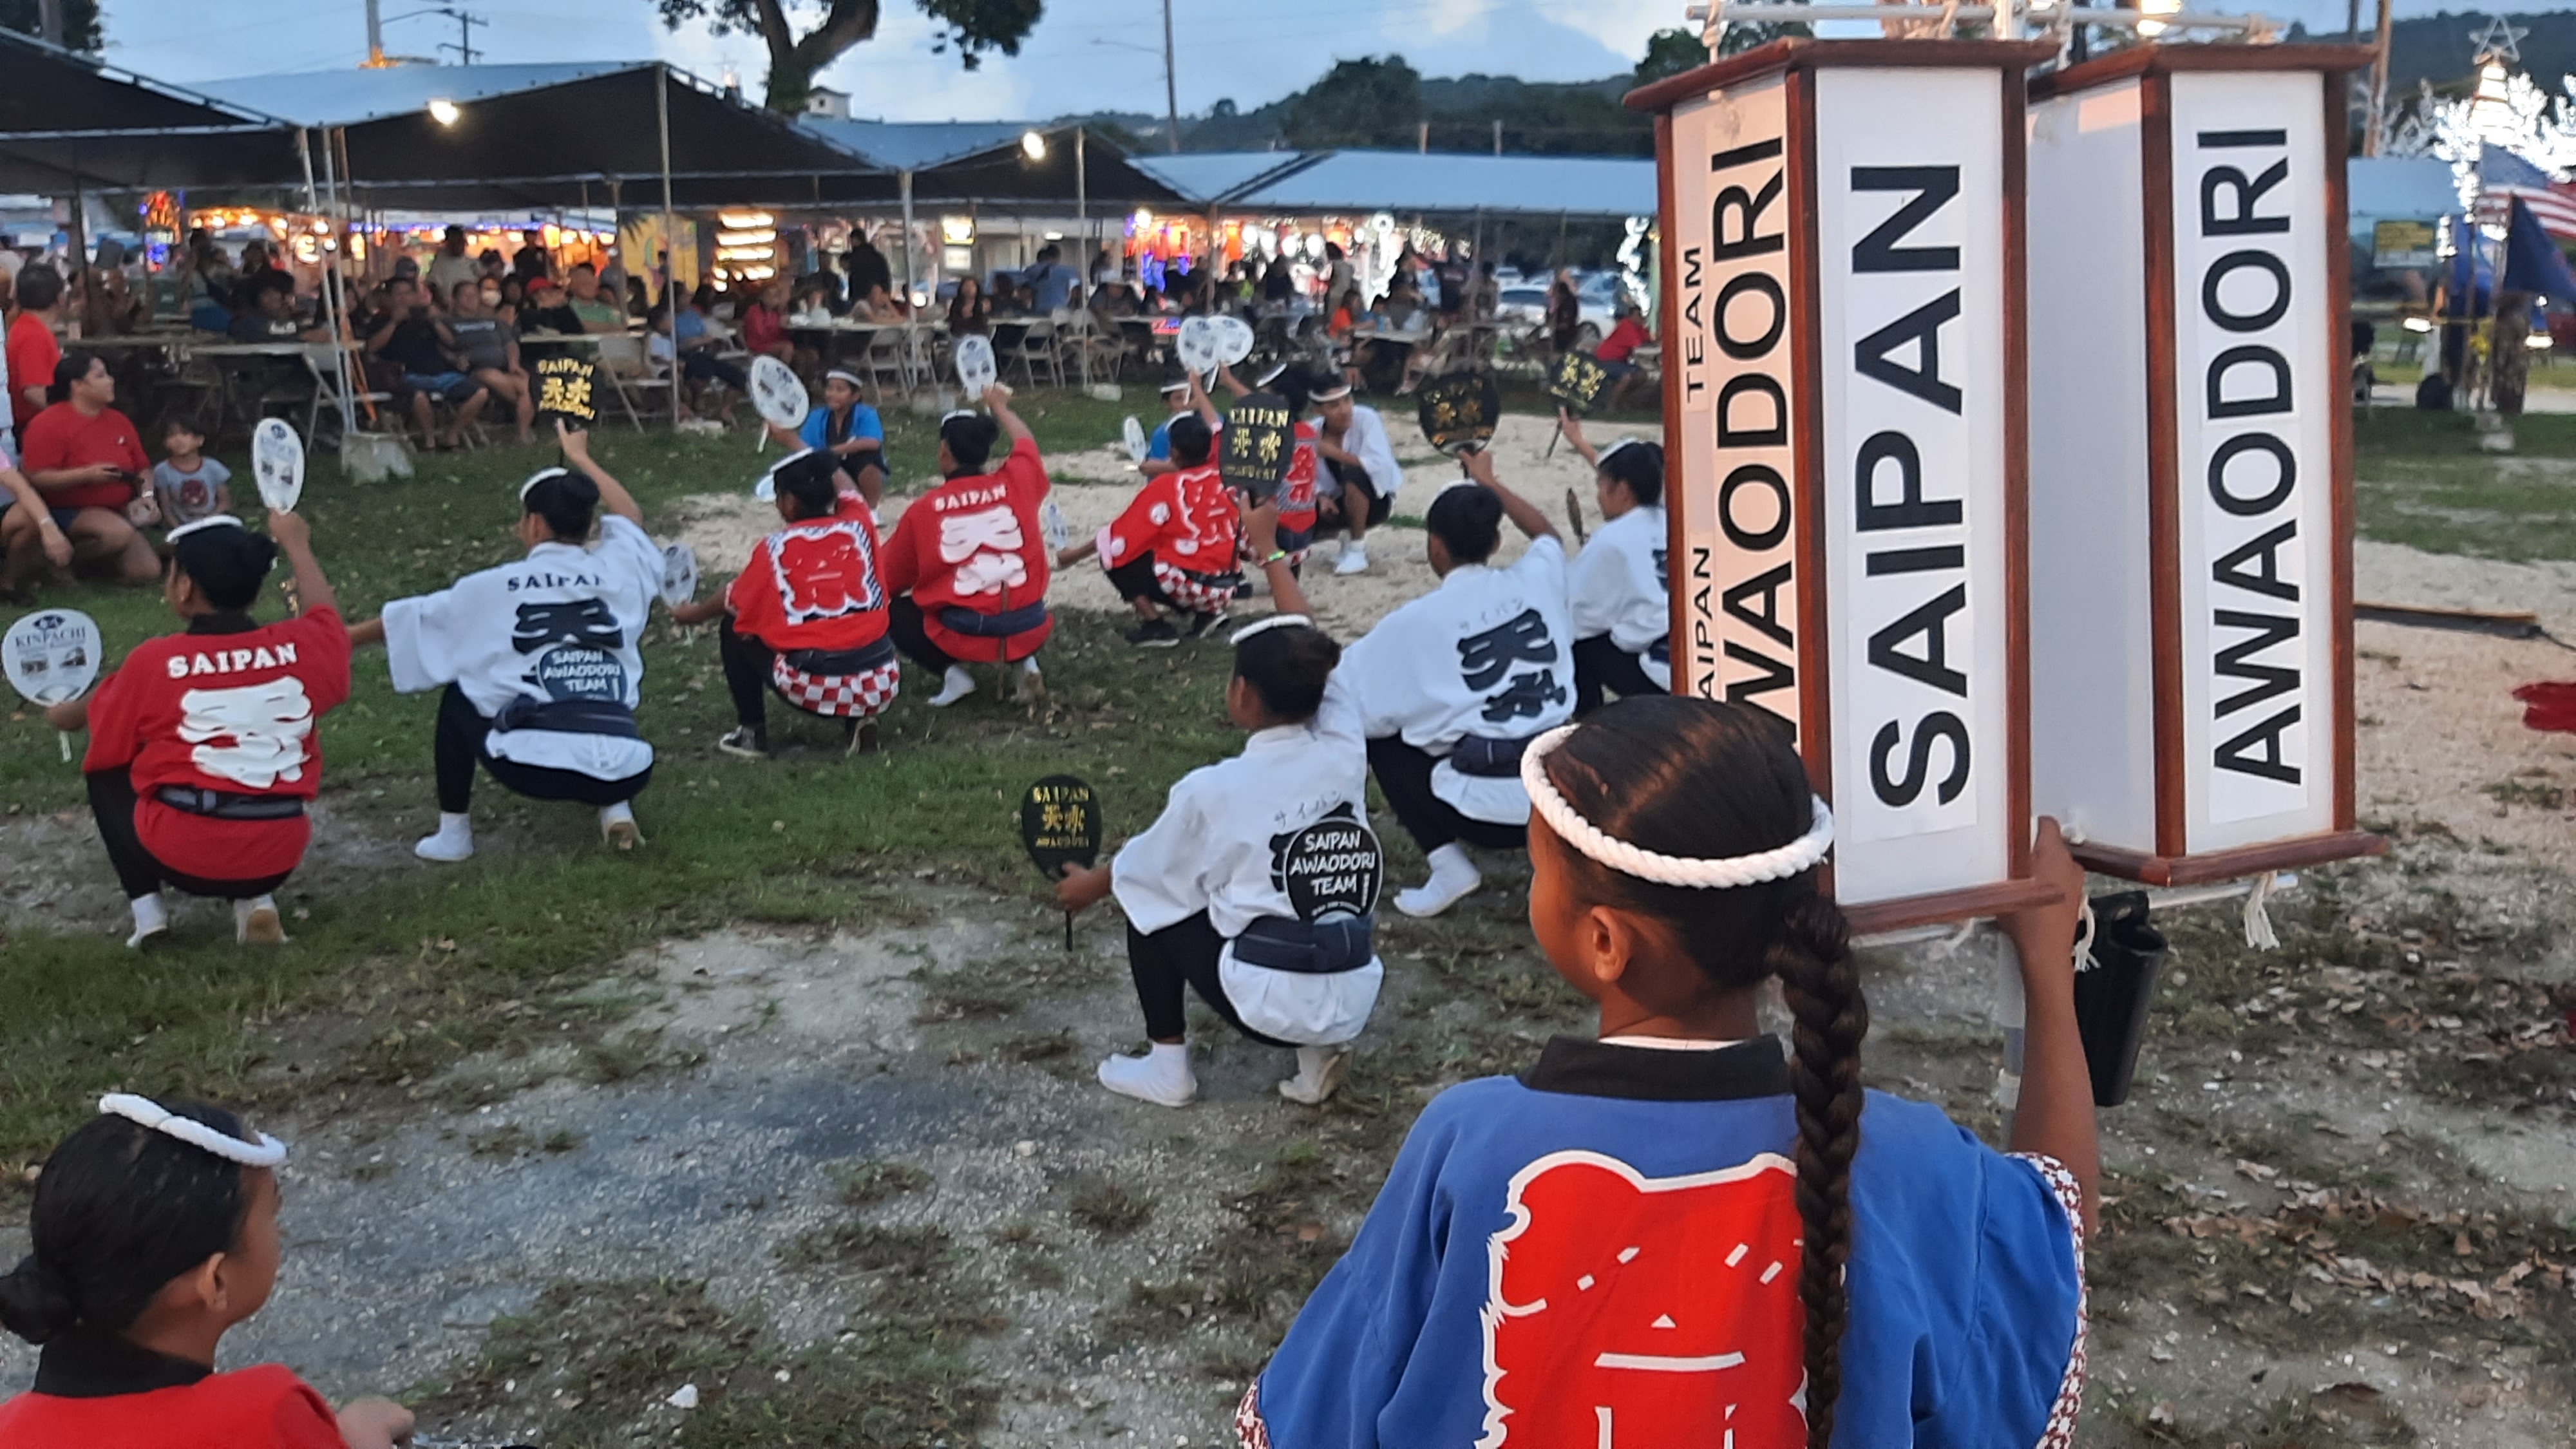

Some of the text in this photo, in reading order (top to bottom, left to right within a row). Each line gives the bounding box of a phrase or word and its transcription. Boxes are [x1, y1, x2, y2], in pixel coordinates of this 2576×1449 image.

[538, 358, 594, 378] SAIPAN
[1711, 136, 1797, 743] WAODORI
[2197, 129, 2302, 786] AWAODORI
[1683, 247, 1715, 699] AIPAN TEAM
[935, 484, 1006, 511] SAIPAN
[1850, 164, 1971, 809] SAIPAN
[167, 643, 298, 678] SAIPAN
[551, 649, 604, 664] SAIPAN
[564, 677, 608, 693] TEAM
[1033, 786, 1089, 803] SAIPAN
[1304, 830, 1361, 853] SAIPAN
[1289, 852, 1376, 876] AWAODORI
[1311, 873, 1357, 896] TEAM
